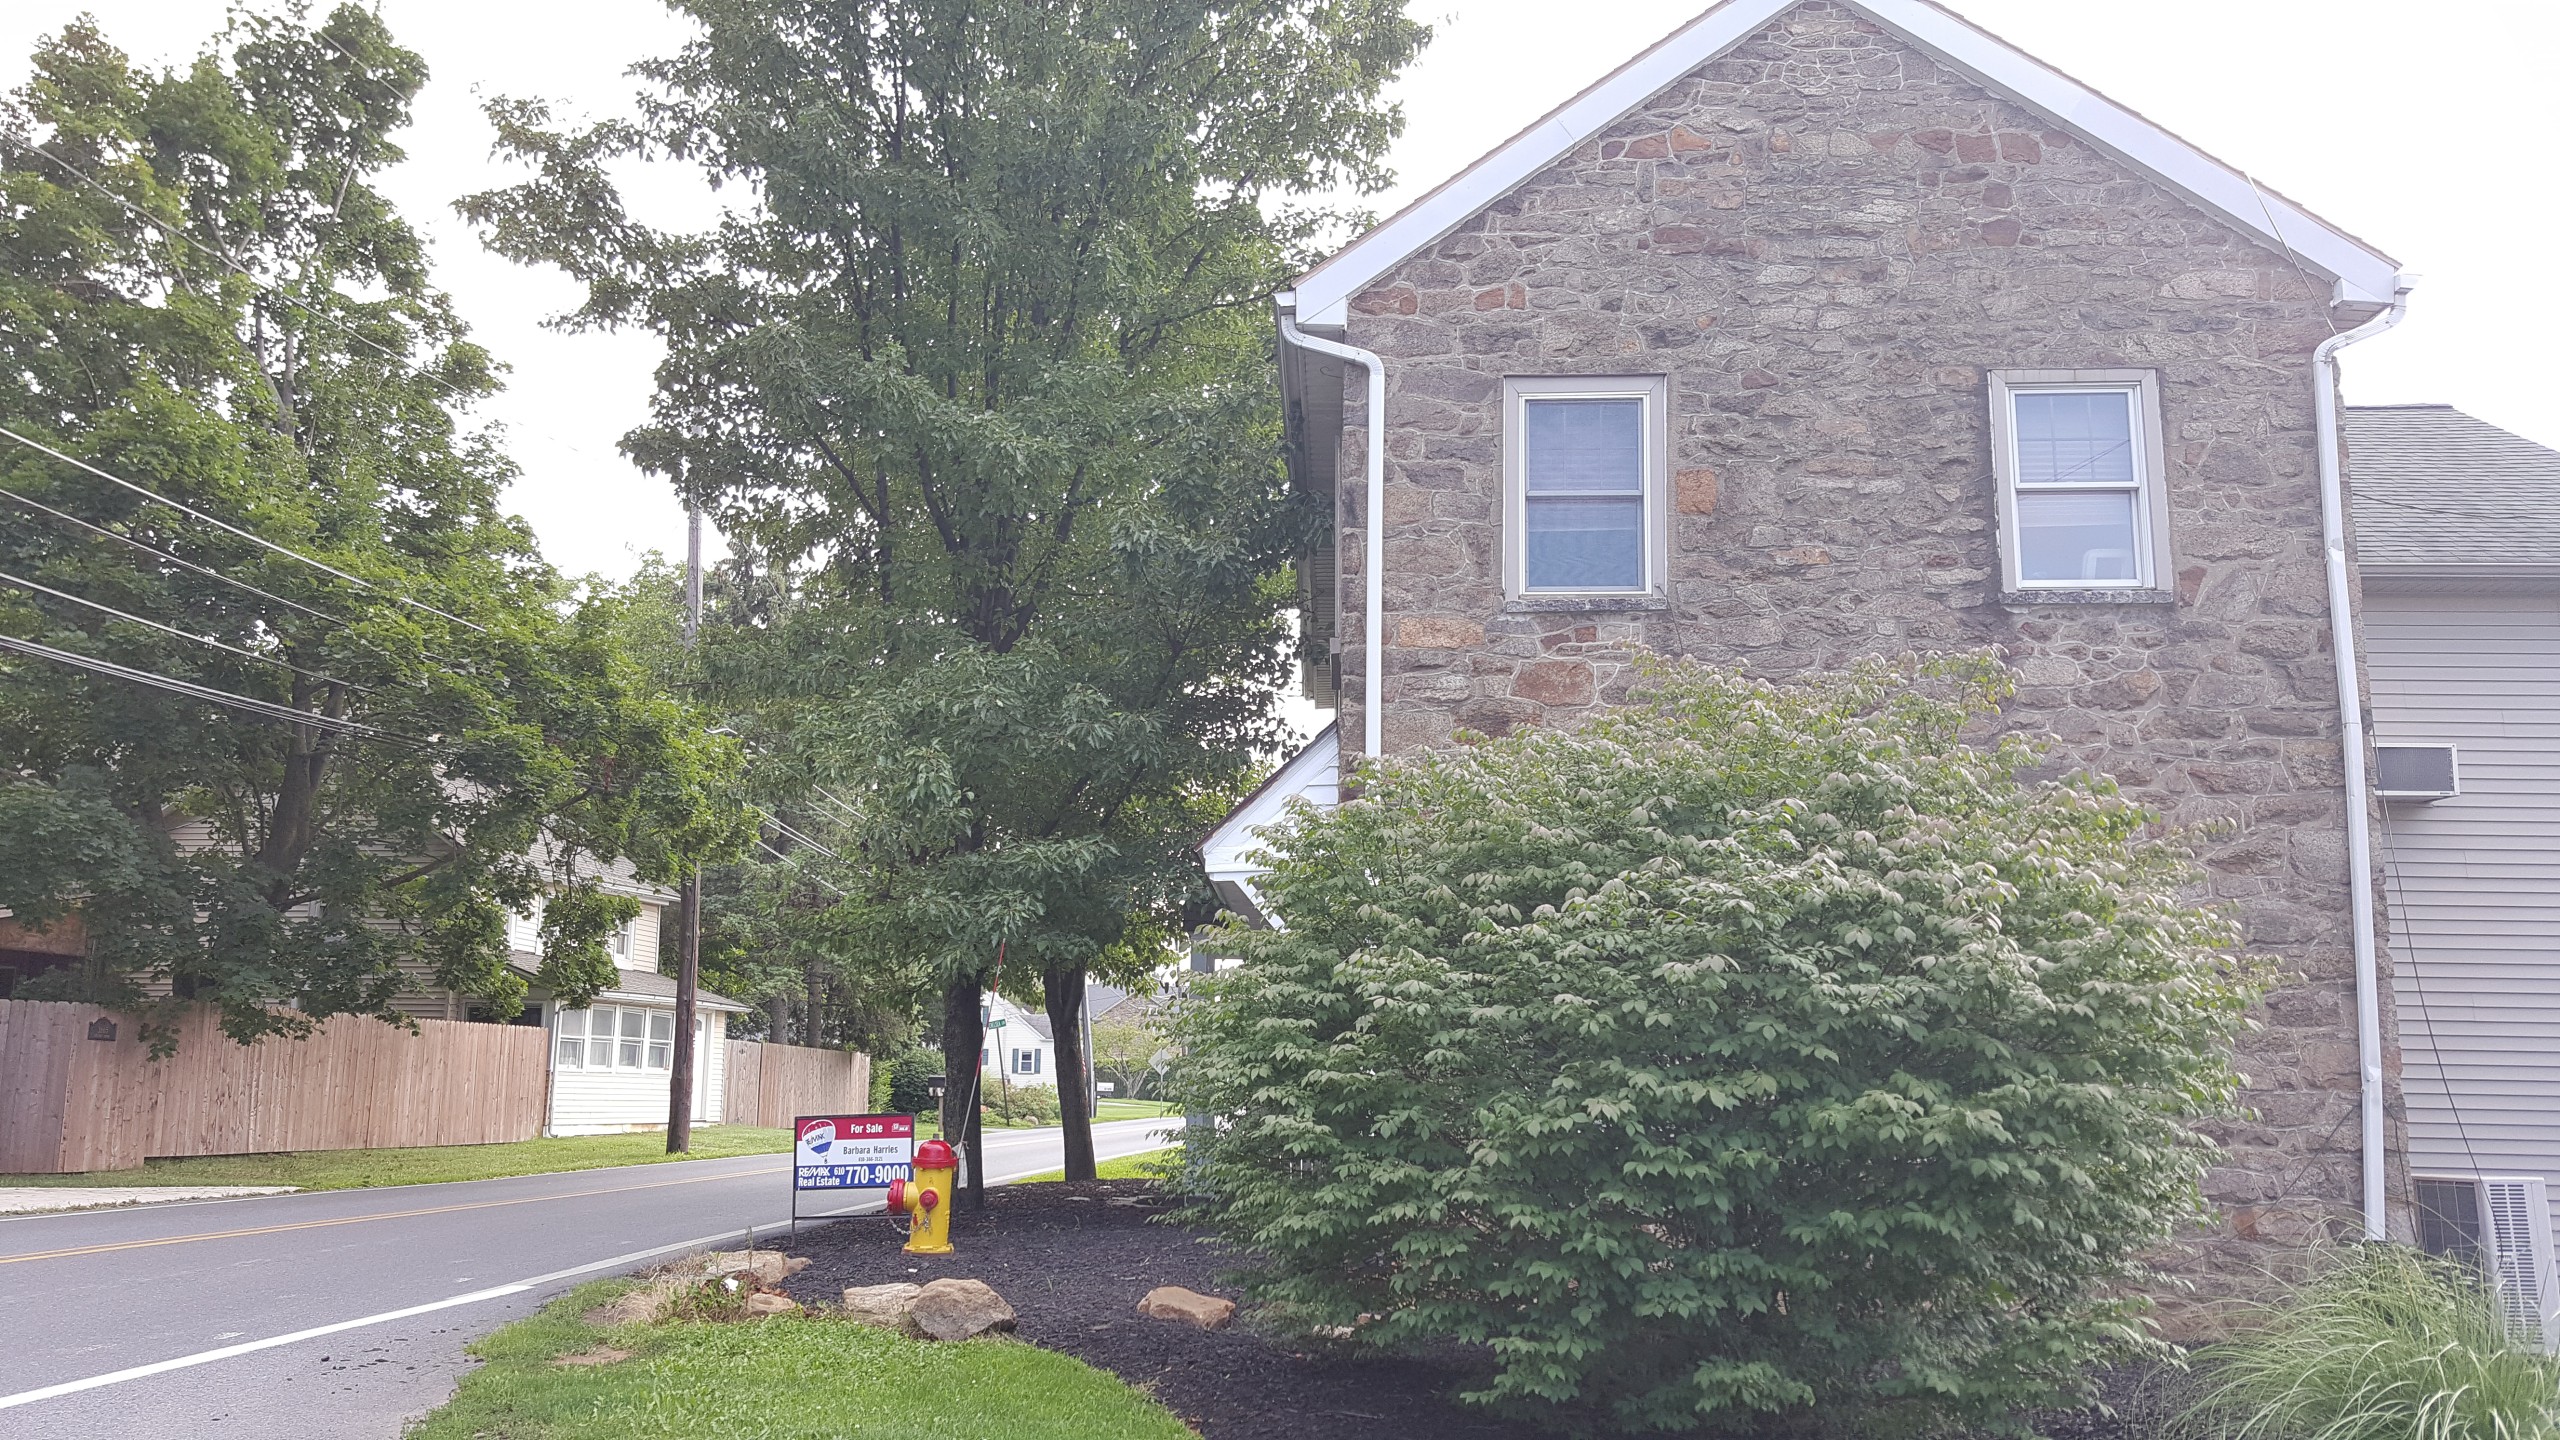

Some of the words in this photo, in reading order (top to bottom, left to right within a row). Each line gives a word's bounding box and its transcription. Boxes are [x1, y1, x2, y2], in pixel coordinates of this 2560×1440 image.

[851, 1124, 864, 1134] For
[866, 1124, 883, 1133] Sale
[843, 1146, 871, 1155] Barbara
[799, 1167, 830, 1176] RE/MAX
[834, 1167, 845, 1175] 610
[847, 1166, 909, 1184] 770-9000
[798, 1177, 815, 1187] Real
[816, 1176, 840, 1186] Estate
